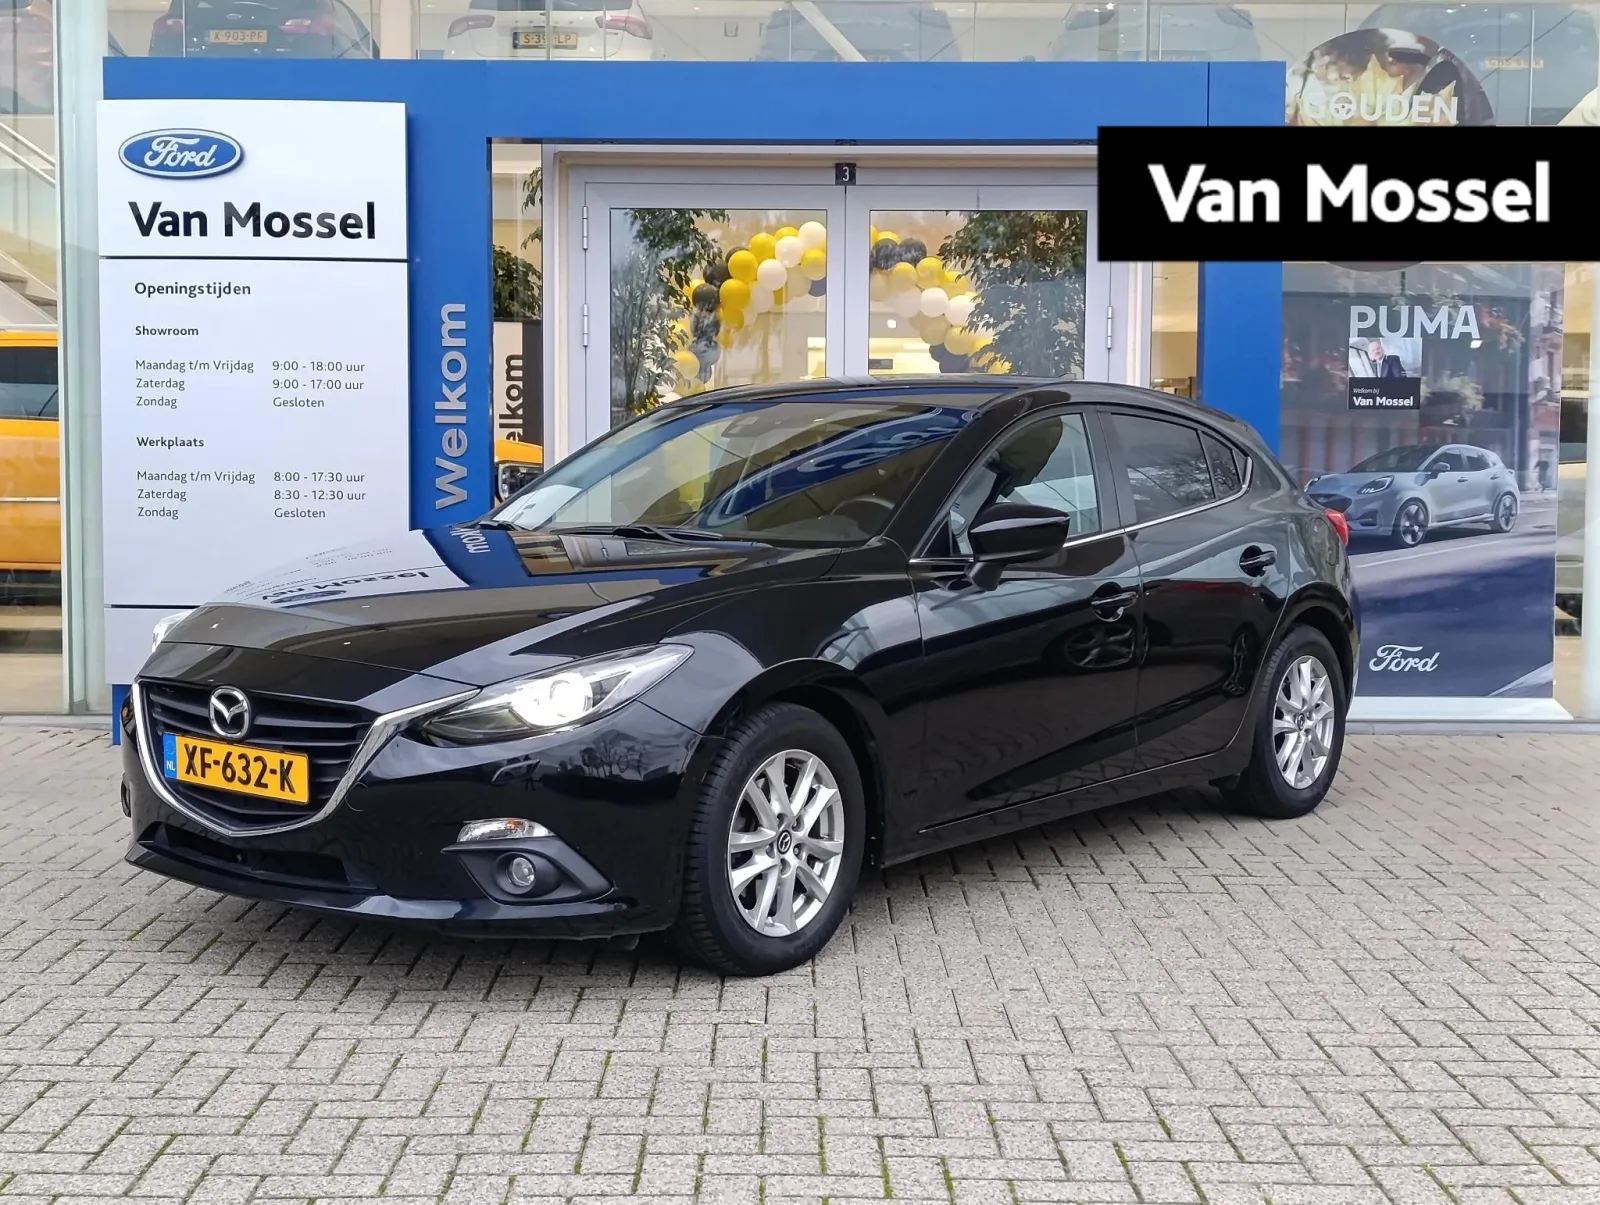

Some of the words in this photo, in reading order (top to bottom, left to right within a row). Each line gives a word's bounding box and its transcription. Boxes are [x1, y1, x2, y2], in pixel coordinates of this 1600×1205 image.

[1303, 92, 1459, 125] GOUDEN
[143, 136, 219, 168] Ford
[842, 166, 850, 182] 3
[128, 201, 209, 238] Van
[223, 201, 376, 240] Mossel
[134, 281, 251, 298] Openingstijden
[1350, 305, 1481, 340] PUMA
[135, 325, 199, 336] Showroom
[135, 359, 186, 373] Maandag
[189, 359, 210, 371] t/m
[213, 359, 254, 374] Vrijdag
[272, 361, 299, 371] 9:00
[310, 361, 343, 372] 18:00
[346, 364, 365, 372] uur
[136, 378, 186, 391] Zaterdag
[272, 379, 299, 389] 9:00
[310, 379, 342, 390] 17:00
[345, 382, 365, 390] uur
[136, 396, 178, 409] Zondag
[273, 397, 325, 408] Gesloten
[434, 303, 468, 510] Welkom
[1353, 396, 1373, 406] Van
[1376, 396, 1414, 406] Mossel
[136, 437, 205, 450] Werkplaats
[137, 471, 188, 484] Maandag
[190, 470, 211, 482] t/m
[214, 470, 256, 484] Vrijdag
[273, 472, 300, 482] 8:00
[311, 472, 343, 483] 17:30
[346, 475, 365, 483] uur
[137, 489, 187, 502] Zaterdag
[273, 490, 300, 500] 8:30
[311, 490, 344, 501] 12:30
[347, 493, 366, 501] uur
[137, 507, 179, 520] Zondag
[274, 508, 326, 519] Gesloten
[1369, 644, 1441, 672] Ford
[166, 759, 176, 772] NL
[183, 743, 296, 794] XF-632-K
